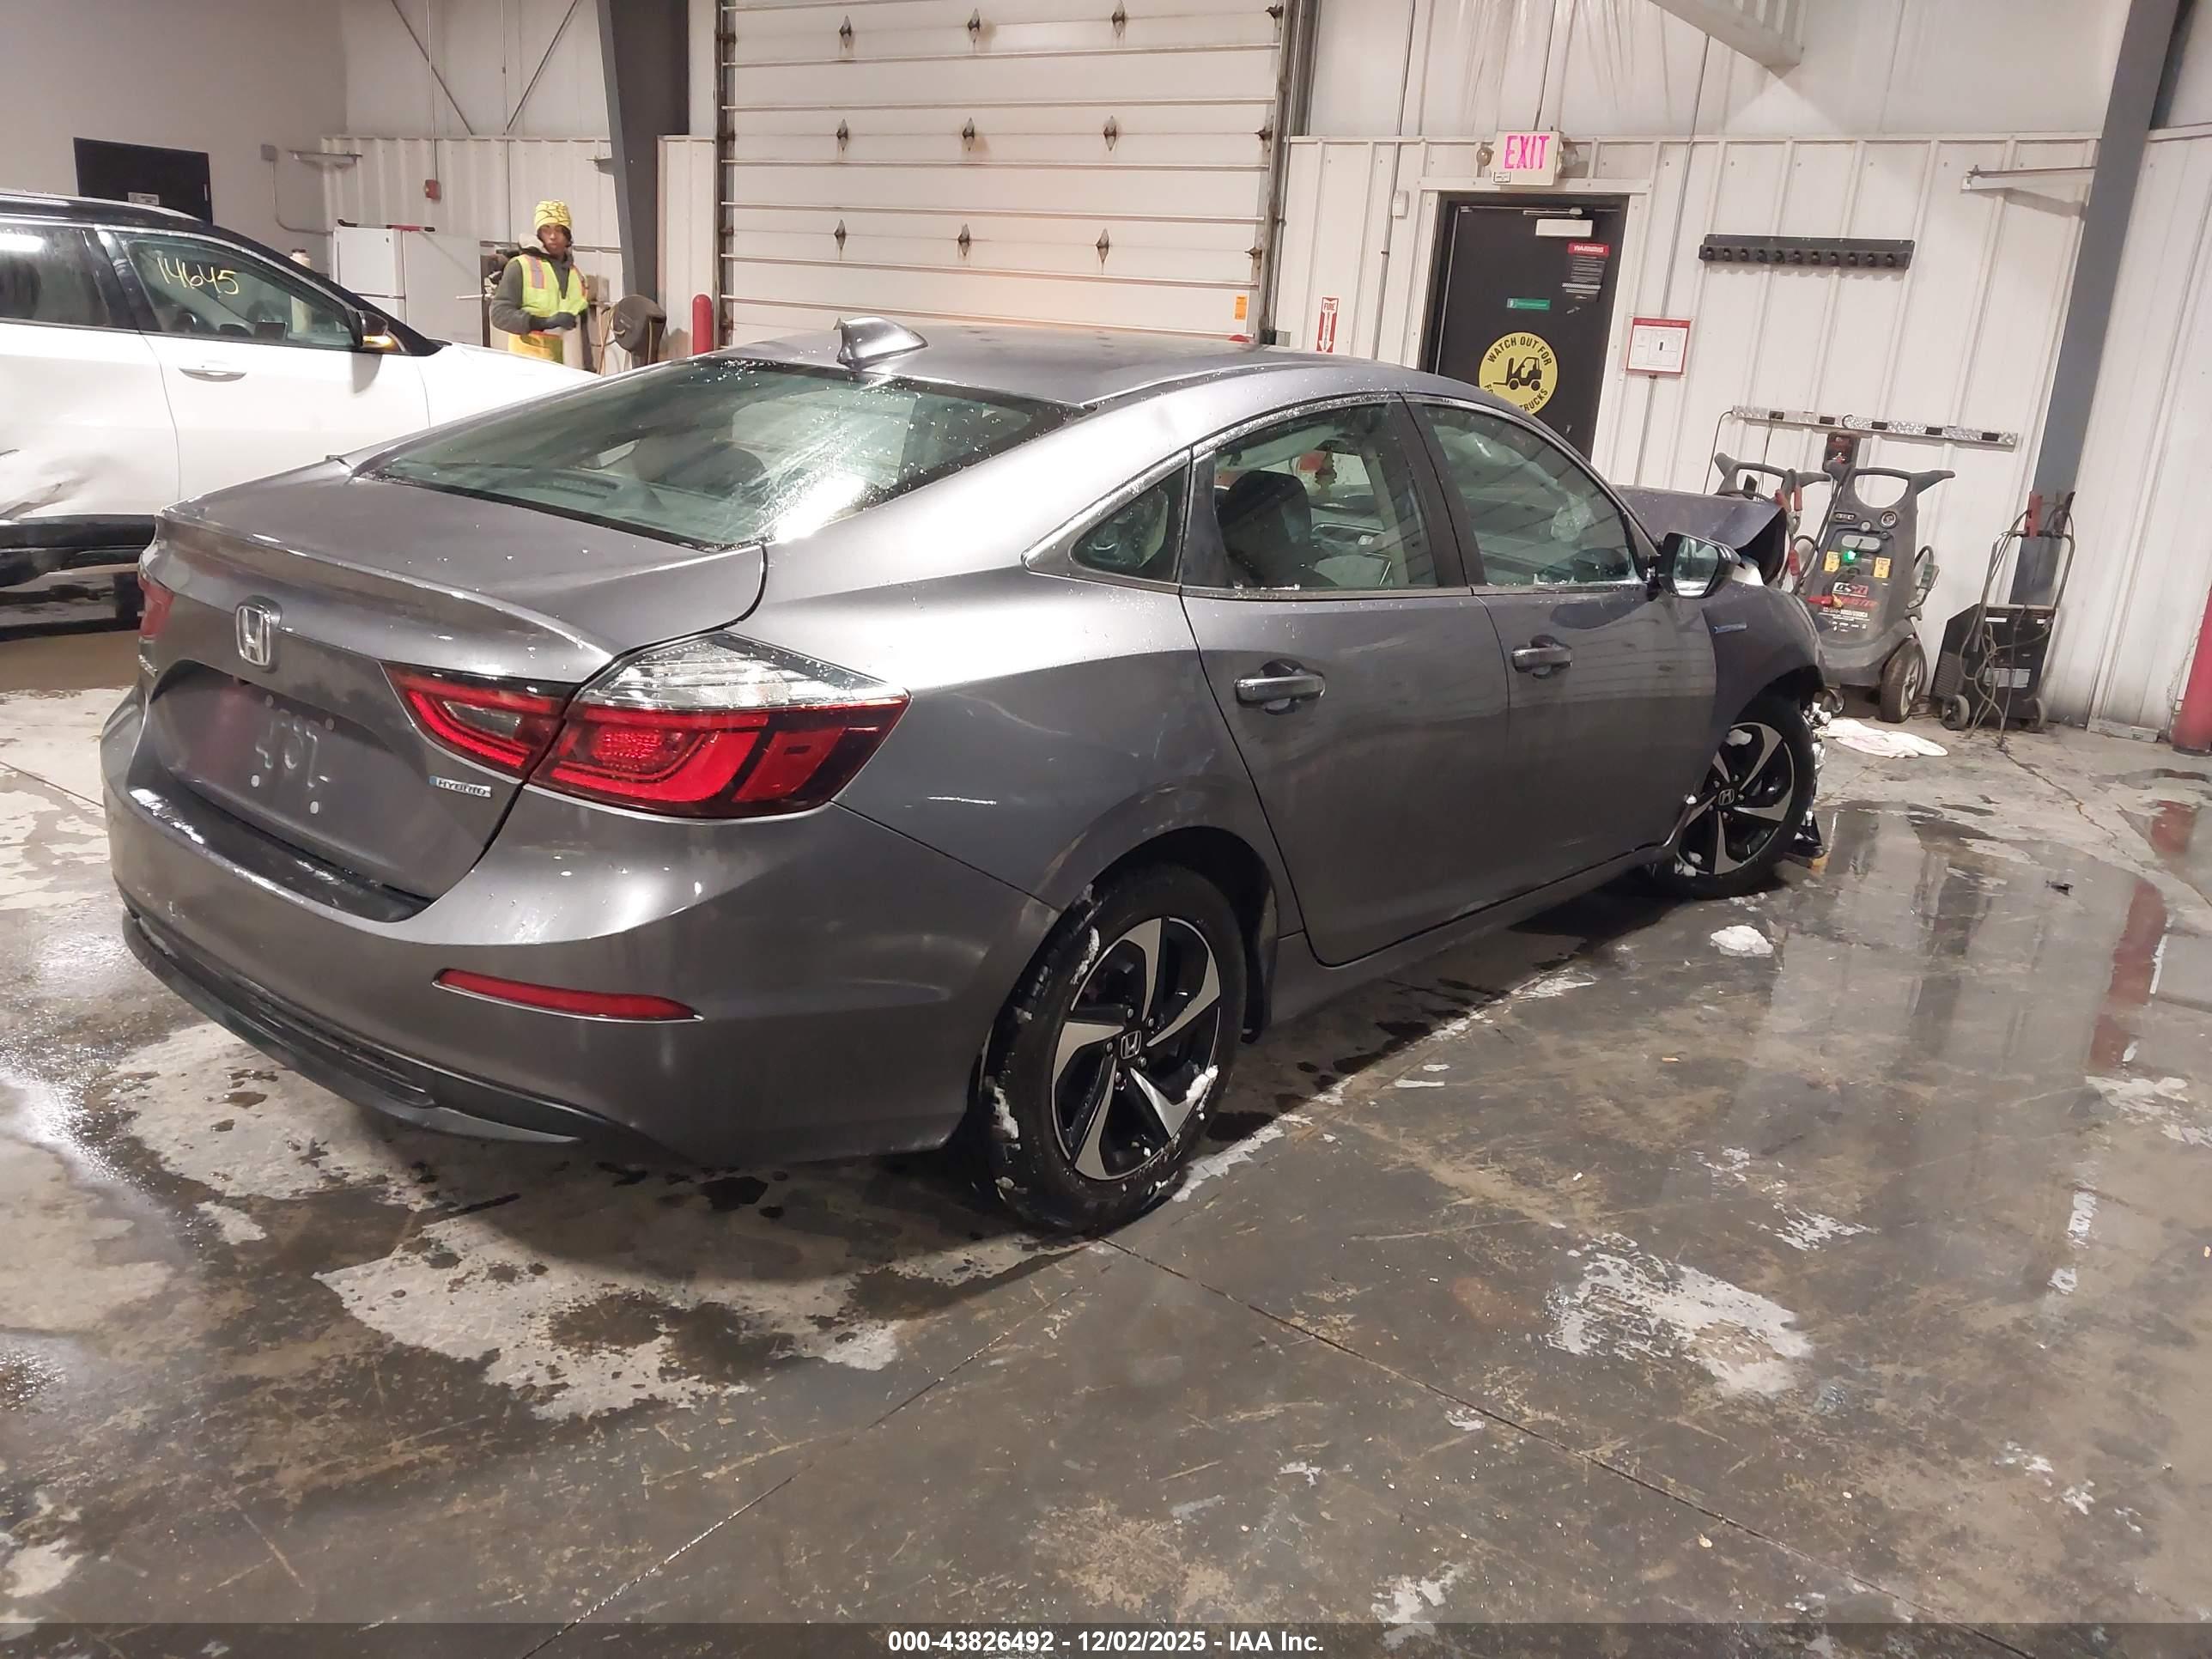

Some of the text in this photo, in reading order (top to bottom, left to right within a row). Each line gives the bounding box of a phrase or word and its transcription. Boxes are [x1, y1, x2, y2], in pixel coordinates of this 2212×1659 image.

[1504, 135, 1550, 169] EXIT
[156, 257, 240, 295] 14645
[1487, 336, 1553, 366] WATCH OUT FOR
[438, 779, 487, 796] HYBRID
